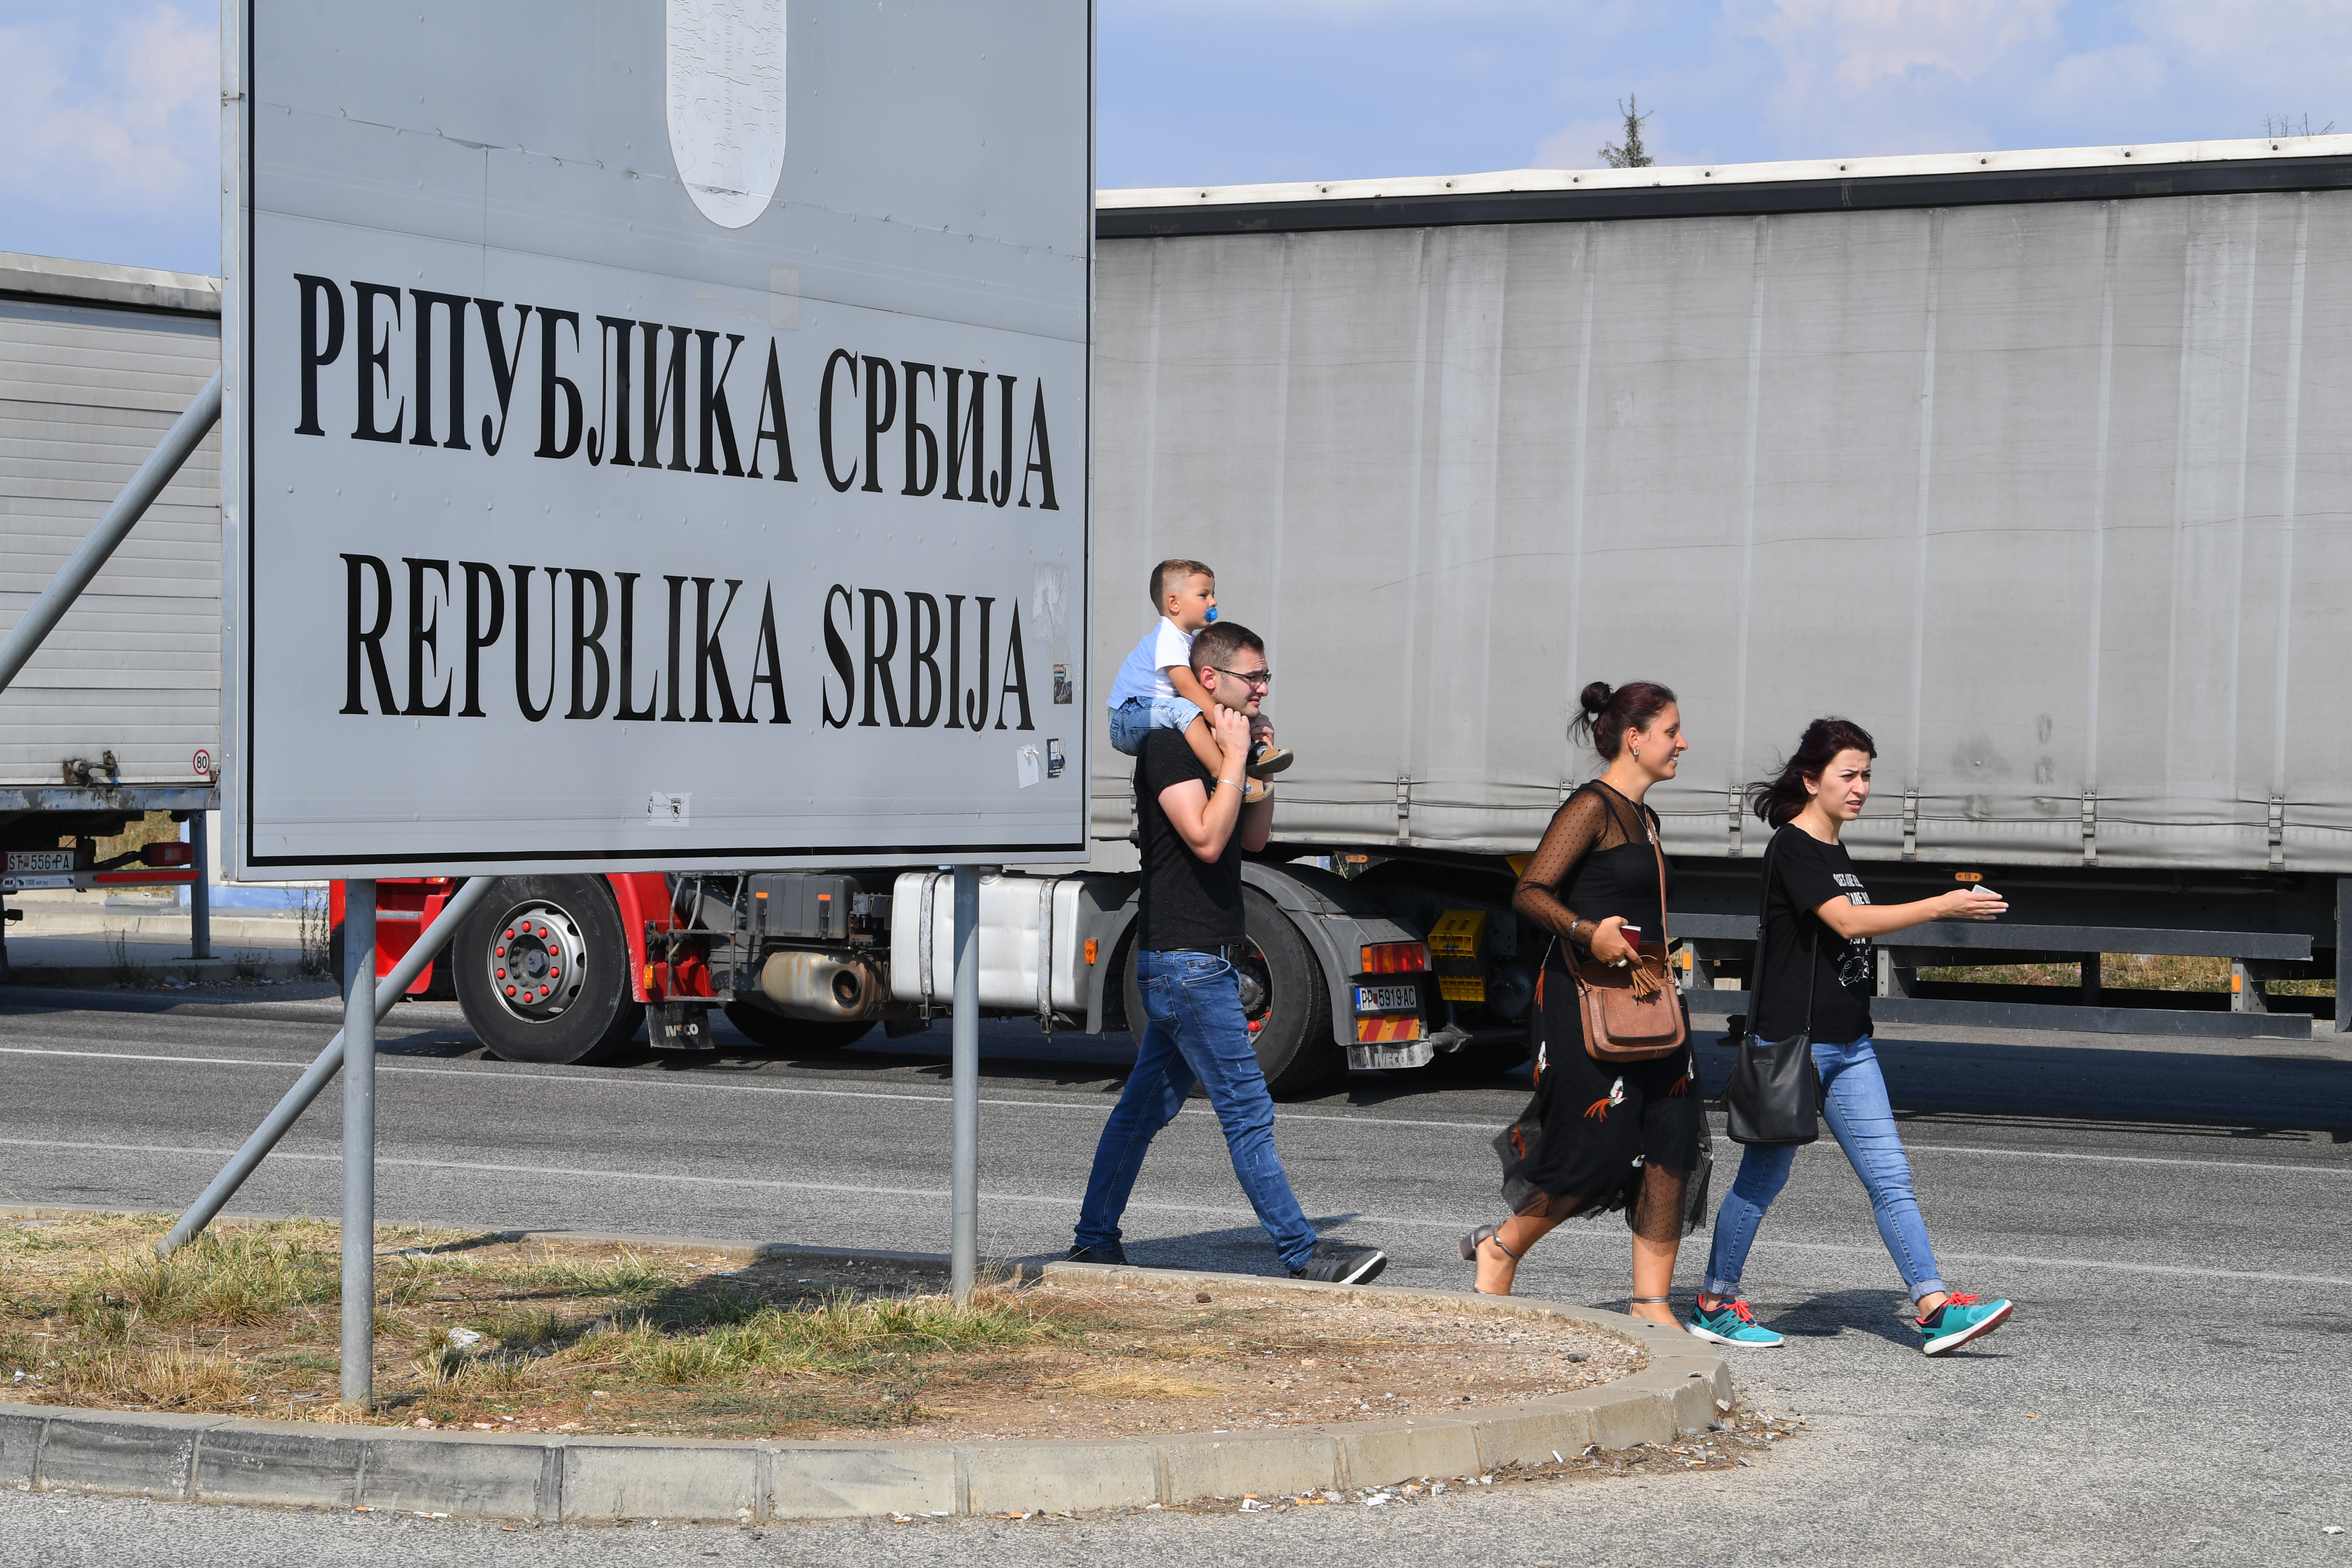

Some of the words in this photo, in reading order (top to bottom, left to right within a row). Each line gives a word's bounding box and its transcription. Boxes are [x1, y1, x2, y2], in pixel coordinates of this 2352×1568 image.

[294, 273, 798, 482] РЕПУБЛИКА
[819, 349, 1059, 510] СРБИЈА
[339, 553, 791, 724] REPUBLIKA
[823, 584, 1034, 732] SRBIJA
[197, 756, 207, 769] 80
[9, 855, 22, 870] ST
[1850, 892, 1865, 906] ARE
[1837, 952, 1846, 962] nap
[1361, 990, 1373, 1008] PP
[664, 1023, 699, 1037] IVECO
[1374, 1052, 1408, 1067] IVECO
